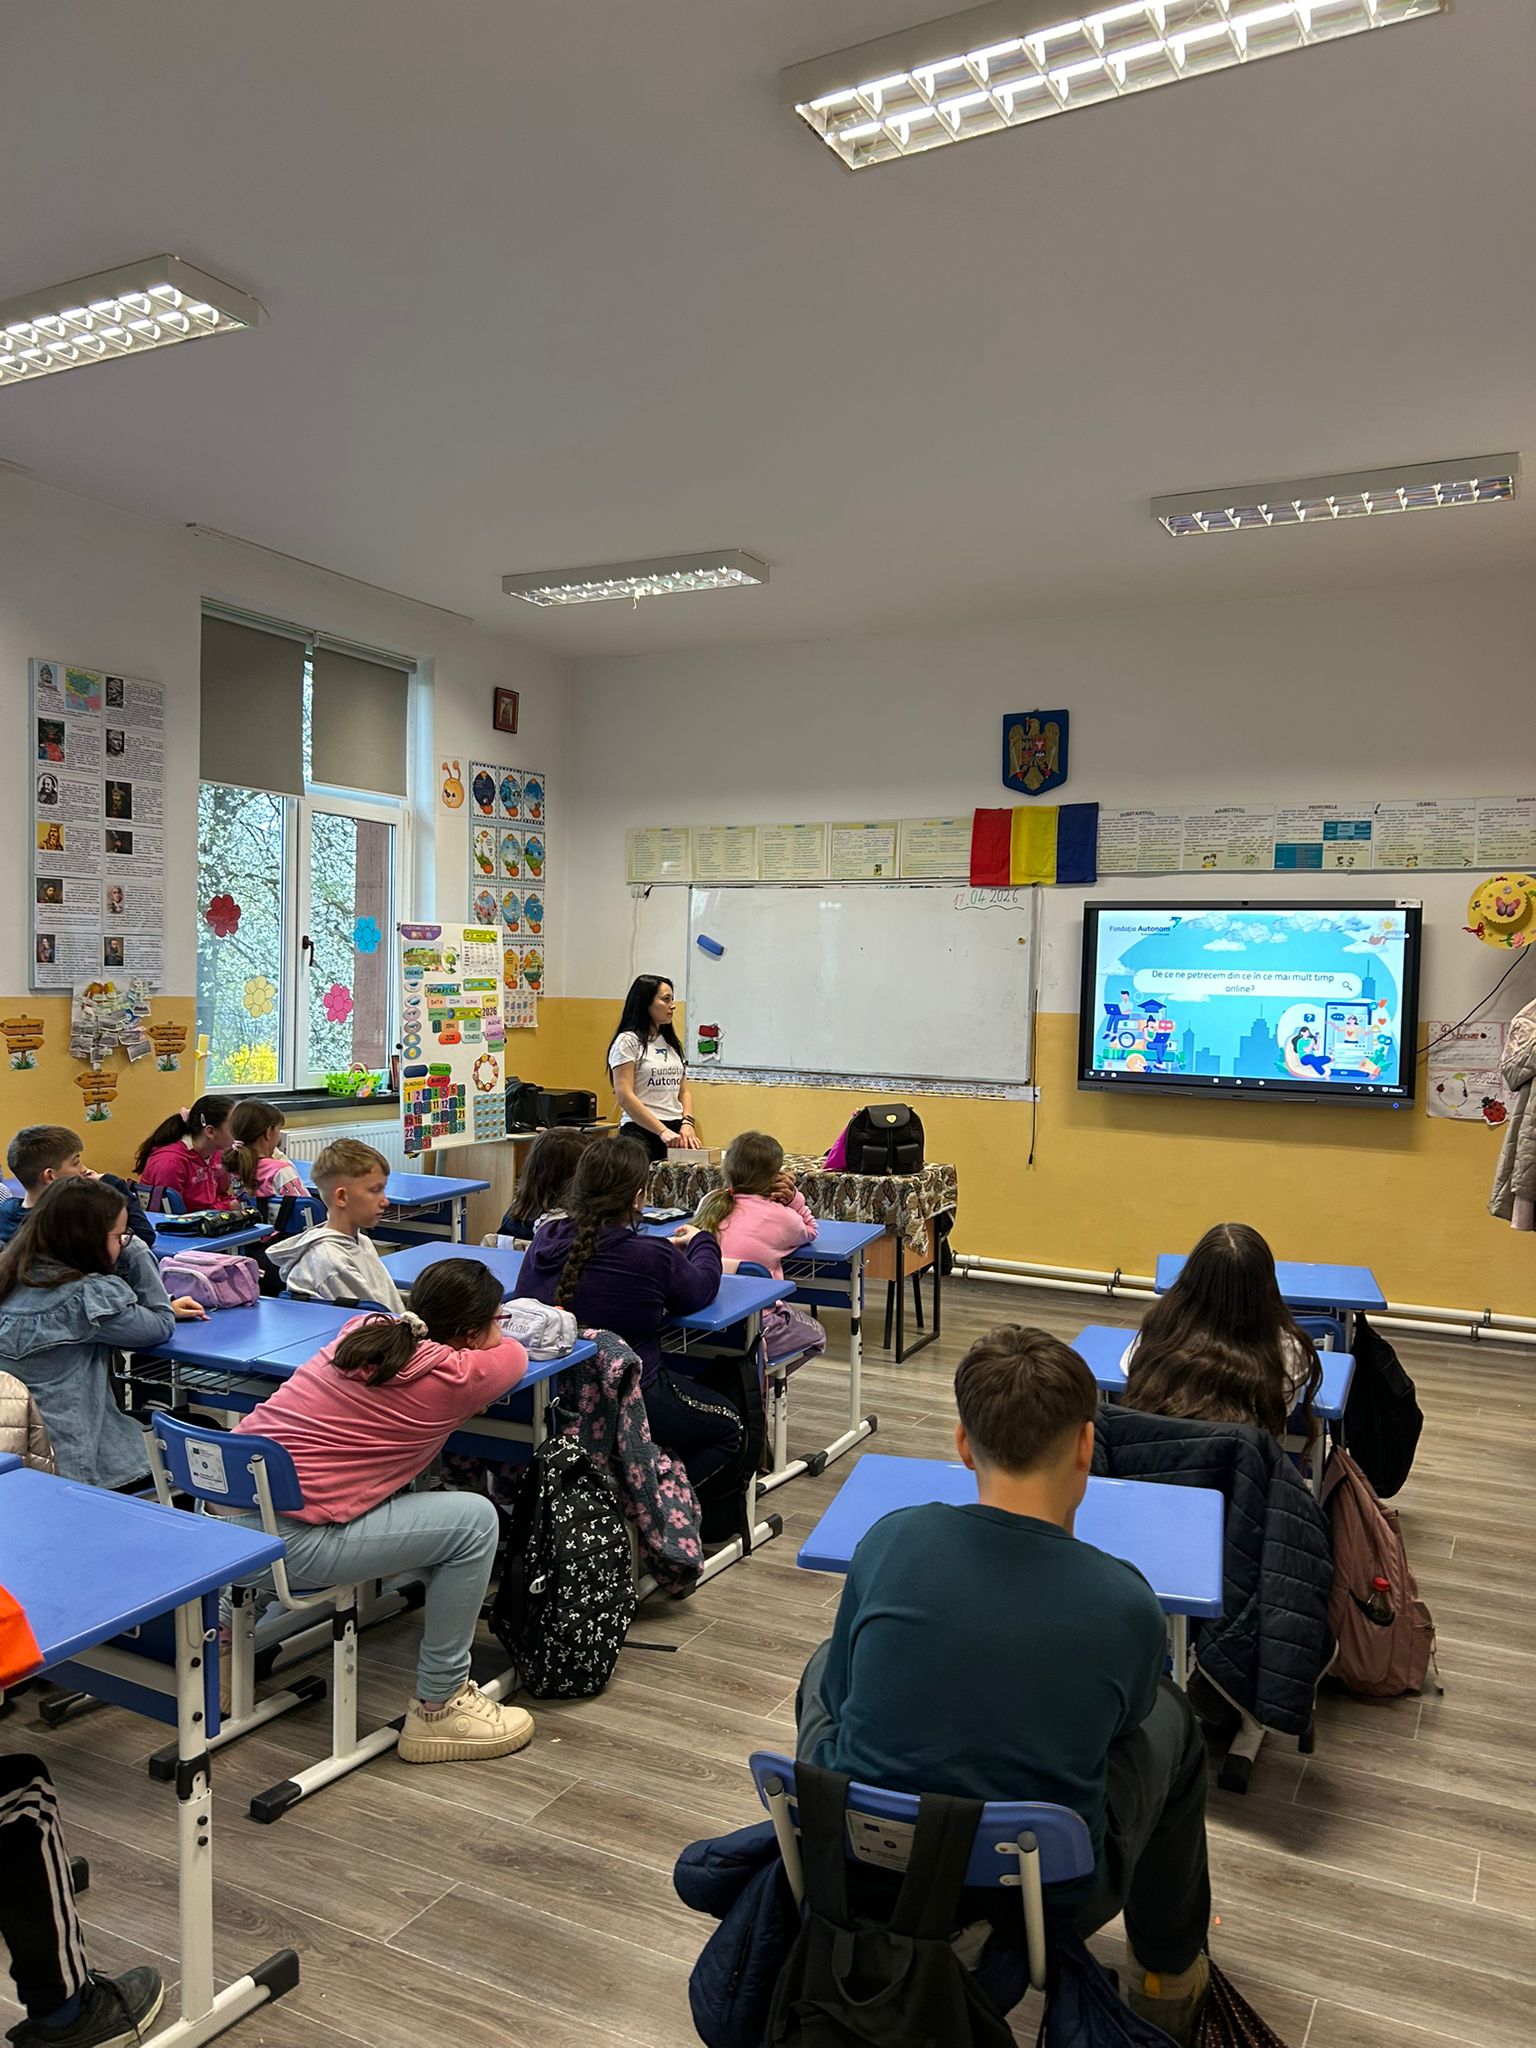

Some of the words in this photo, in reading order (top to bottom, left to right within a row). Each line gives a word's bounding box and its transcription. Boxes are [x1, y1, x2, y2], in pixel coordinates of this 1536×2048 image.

[1152, 969, 1163, 978] De
[1164, 971, 1174, 979] ce
[1175, 971, 1186, 979] ne
[1187, 971, 1226, 980] petrecem
[1227, 972, 1240, 980] din
[1275, 973, 1290, 981] mai
[1292, 973, 1312, 981] mult
[1314, 974, 1335, 983] timp
[1225, 984, 1255, 993] online?
[482, 1006, 497, 1017] 2026
[647, 1077, 680, 1087] Autono
[433, 1101, 439, 1109] 11
[441, 1099, 448, 1108] 12
[406, 1115, 413, 1125] 15
[415, 1116, 422, 1125] 16
[458, 1109, 465, 1119] 21
[406, 1129, 413, 1138] 22
